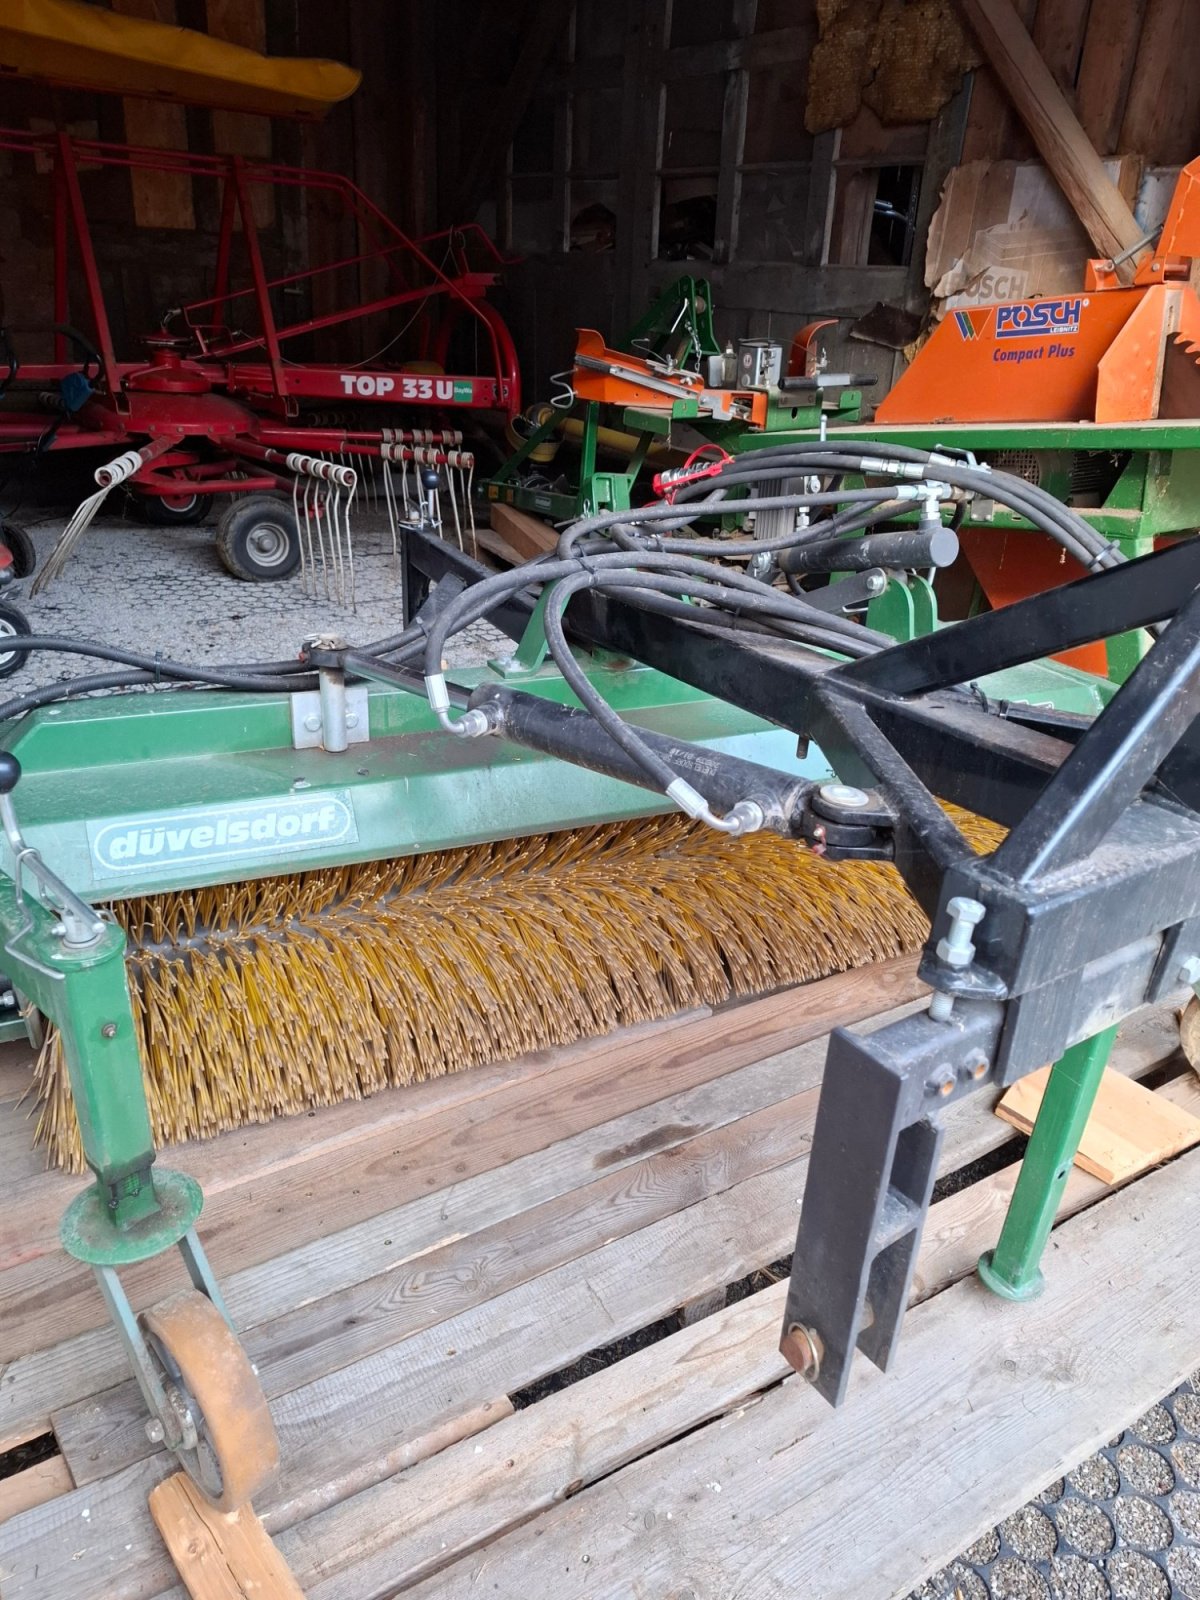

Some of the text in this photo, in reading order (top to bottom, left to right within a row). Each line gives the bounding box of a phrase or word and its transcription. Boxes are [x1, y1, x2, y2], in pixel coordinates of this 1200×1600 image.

[997, 300, 1081, 330] POSCH
[993, 343, 1075, 363] Compact Plus
[341, 375, 453, 400] TOP 33 U
[109, 806, 336, 860] düvelsdorf
